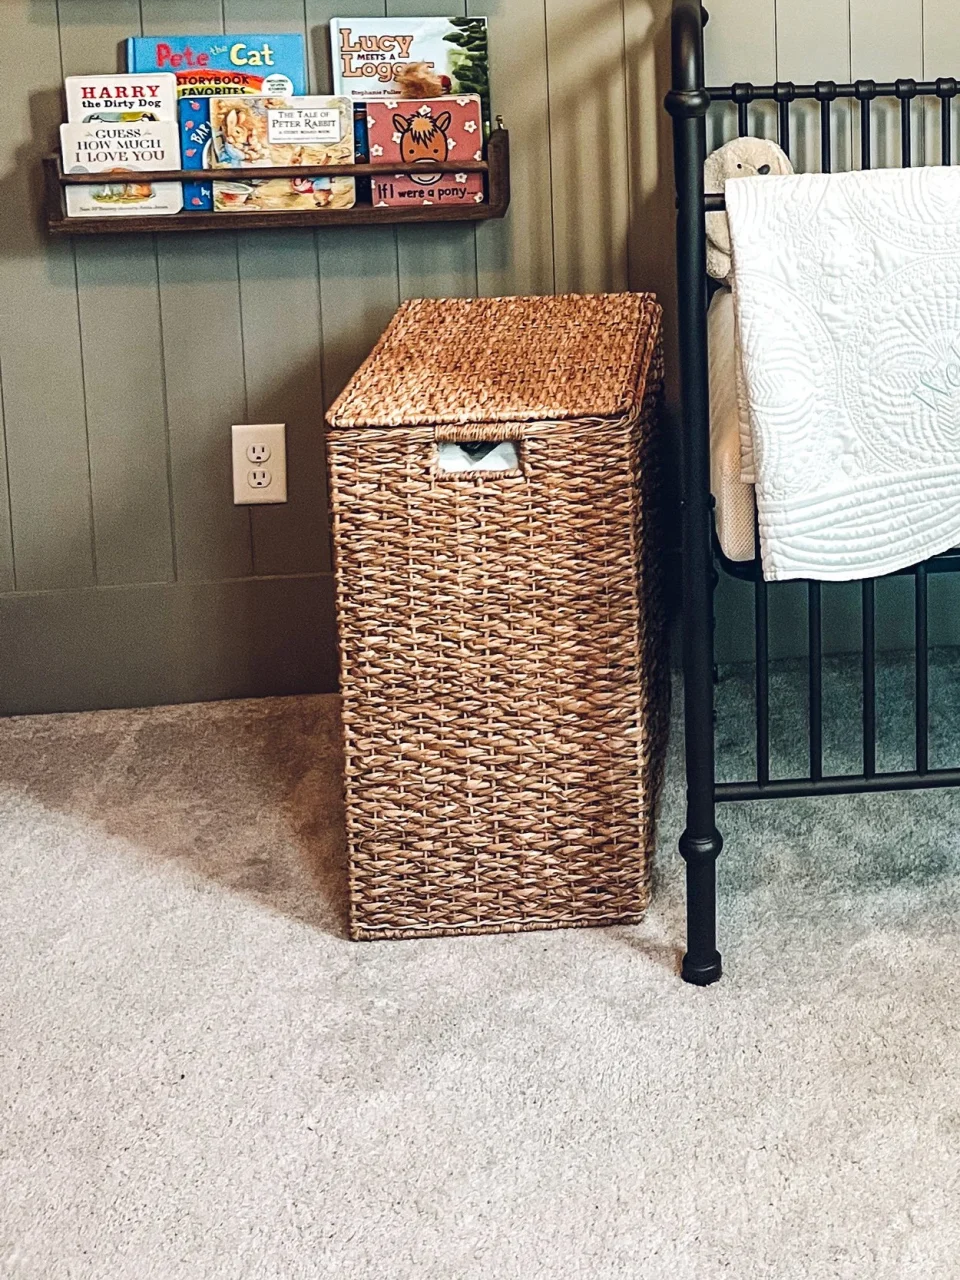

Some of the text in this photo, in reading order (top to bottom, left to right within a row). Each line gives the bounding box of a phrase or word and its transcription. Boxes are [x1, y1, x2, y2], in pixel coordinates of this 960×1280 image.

[339, 28, 413, 58] Lucy
[155, 42, 275, 67] Pete the Cat
[177, 75, 249, 86] STORYBOOK
[81, 85, 160, 99] HARRY
[182, 87, 246, 97] FAVORITES
[82, 99, 162, 109] the Dirty Dog
[297, 110, 318, 118] TALE
[272, 119, 336, 129] PETER RABBIT
[95, 129, 141, 138] GUESS
[77, 139, 161, 150] HOW MUCH
[75, 150, 165, 162] I LOVE YOU
[378, 183, 388, 199] If
[389, 183, 394, 198] I
[397, 189, 425, 198] were
[427, 189, 435, 197] a
